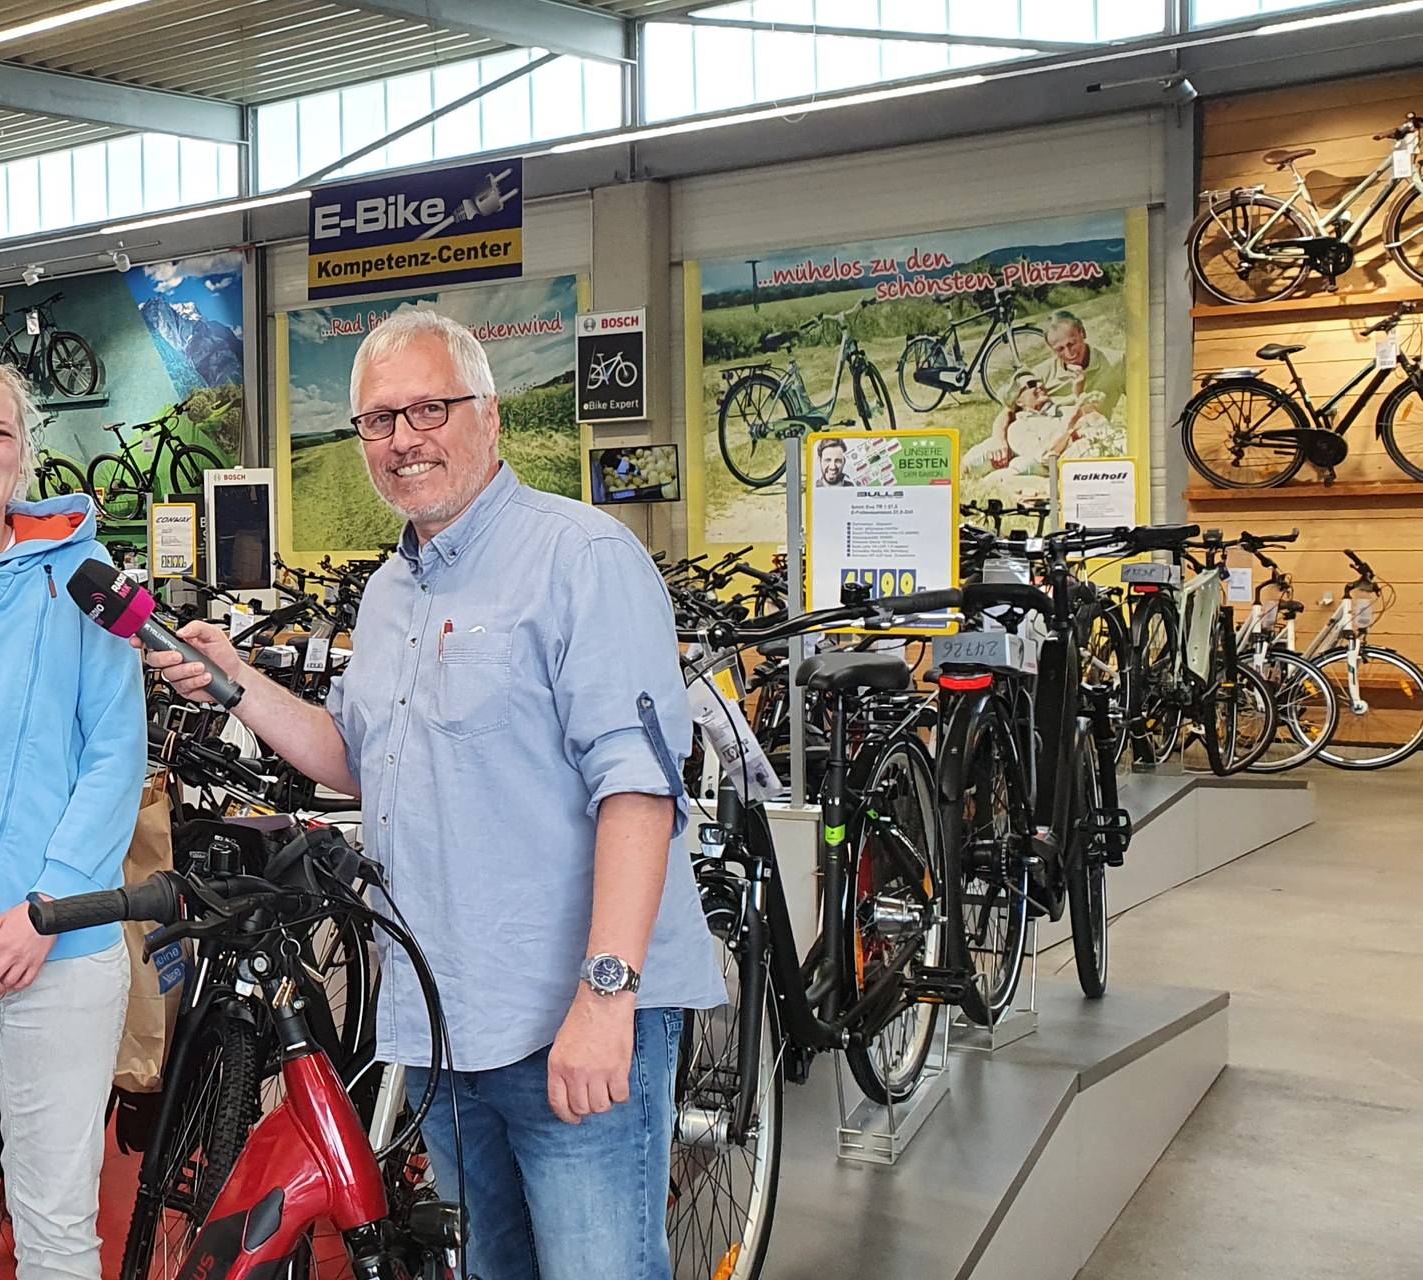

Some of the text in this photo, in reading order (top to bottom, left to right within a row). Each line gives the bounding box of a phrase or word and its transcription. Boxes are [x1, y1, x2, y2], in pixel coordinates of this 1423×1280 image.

[315, 194, 445, 240] E-Bike
[317, 241, 512, 279] Kompetenz-Center
[870, 260, 898, 275] zu
[907, 247, 952, 272] den
[876, 258, 1102, 301] schönsten Plätzen
[601, 316, 639, 329] BOSCH
[583, 399, 639, 410] eBike Expert
[904, 447, 942, 456] UNSERE
[899, 458, 948, 469] BESTEN
[1073, 472, 1128, 480] Kalkhoff
